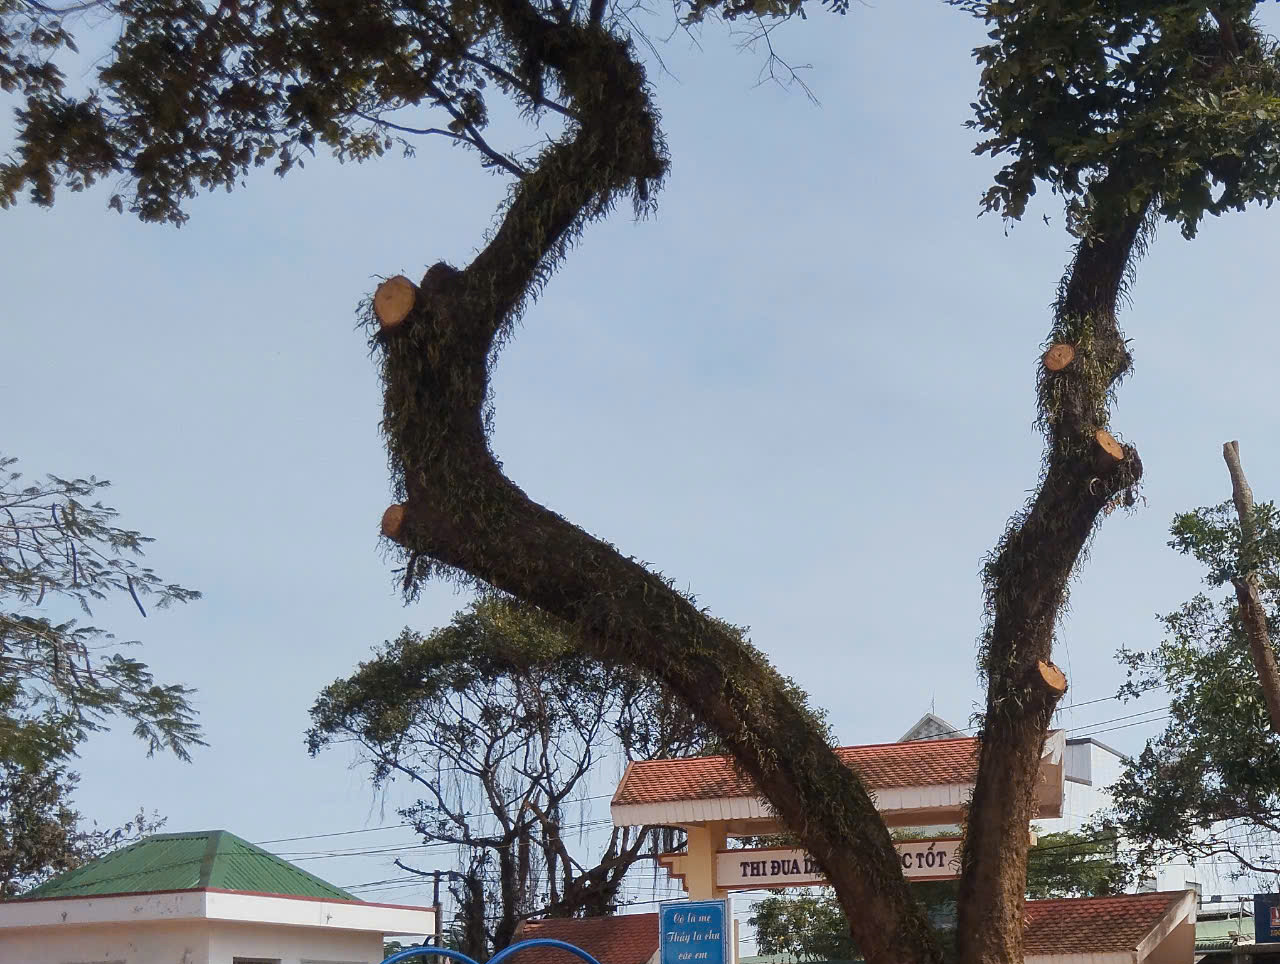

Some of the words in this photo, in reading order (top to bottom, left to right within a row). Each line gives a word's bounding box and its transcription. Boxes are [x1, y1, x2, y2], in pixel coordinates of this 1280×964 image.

[740, 860, 767, 877] THI
[771, 859, 801, 876] ĐUA
[915, 842, 947, 869] TỐT
